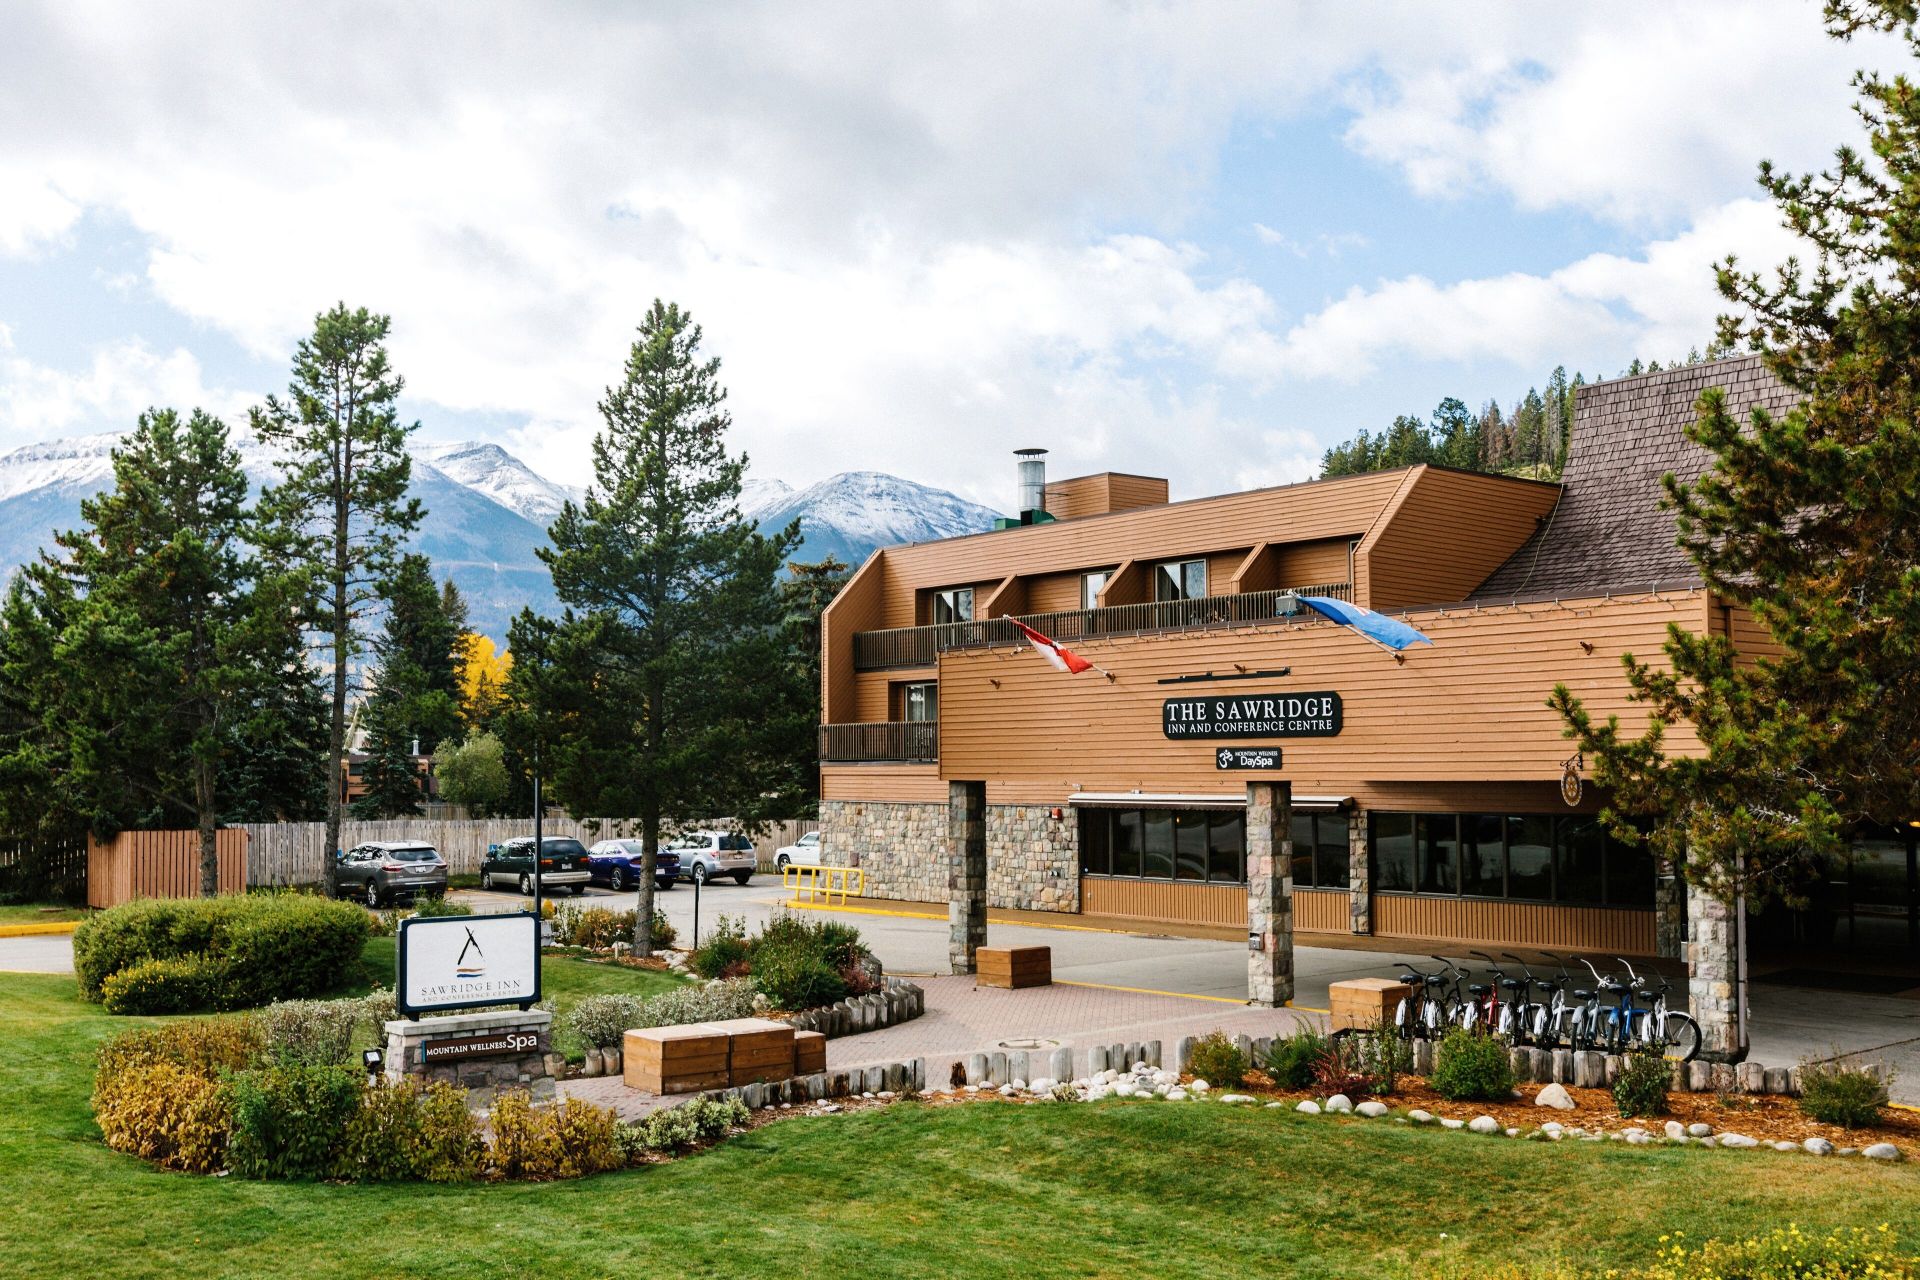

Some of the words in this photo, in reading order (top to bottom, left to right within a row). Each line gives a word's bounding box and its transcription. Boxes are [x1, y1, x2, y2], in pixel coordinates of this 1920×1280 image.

[1167, 702, 1207, 721] THE
[1215, 697, 1334, 720] SAWRIDGE
[1168, 723, 1186, 734] INN
[1189, 722, 1211, 733] AND
[1214, 721, 1285, 732] CONFERENCE
[1288, 719, 1333, 731] CENTRE
[1240, 756, 1273, 768] DaySpa
[421, 982, 492, 996] SAWRIDGE
[498, 980, 521, 990] INN
[441, 992, 490, 1001] CONFERENCE
[493, 989, 520, 997] CENTRE
[426, 1044, 468, 1056] MOUNTAIN
[469, 1041, 507, 1051] WELLNESS
[506, 1034, 537, 1051] Spa
